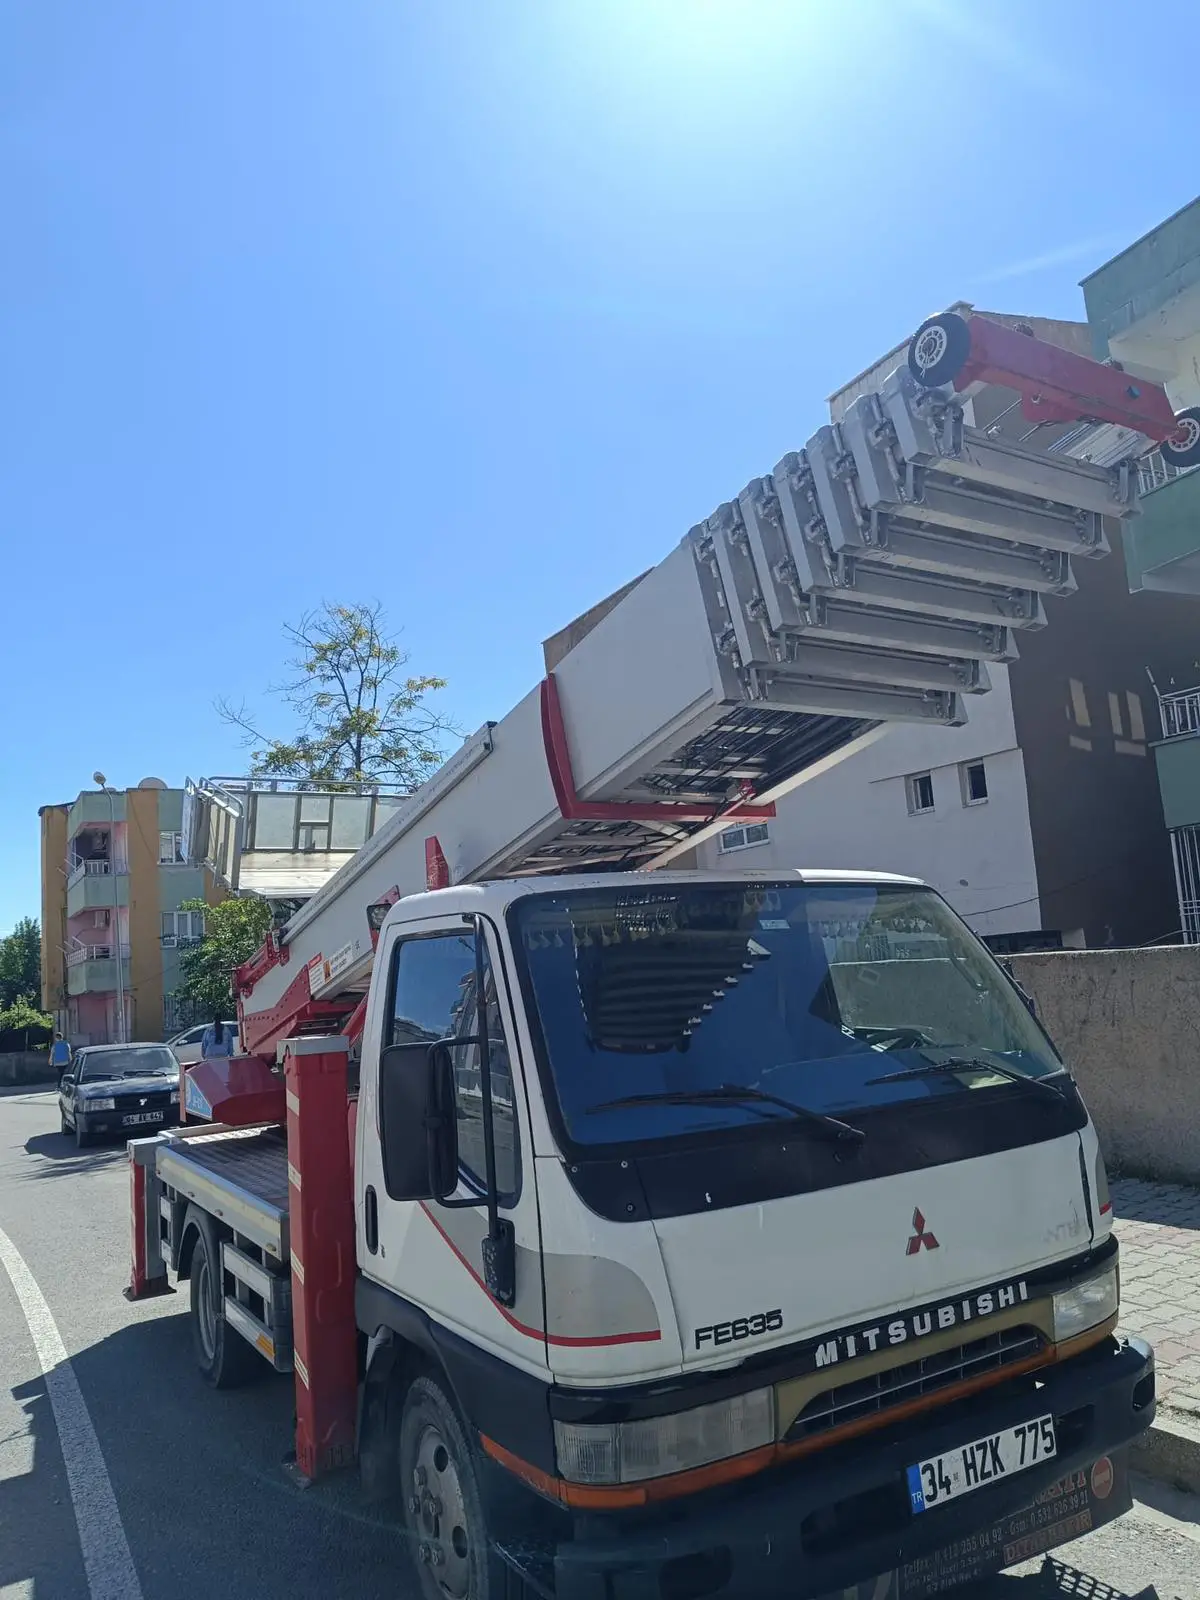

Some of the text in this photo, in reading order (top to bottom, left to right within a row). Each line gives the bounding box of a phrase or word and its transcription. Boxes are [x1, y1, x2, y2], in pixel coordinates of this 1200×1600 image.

[695, 1309, 783, 1349] FE635
[815, 1281, 1029, 1367] MITSUBISHI
[921, 1417, 1055, 1503] 34 HZK 775
[911, 1491, 924, 1504] TR
